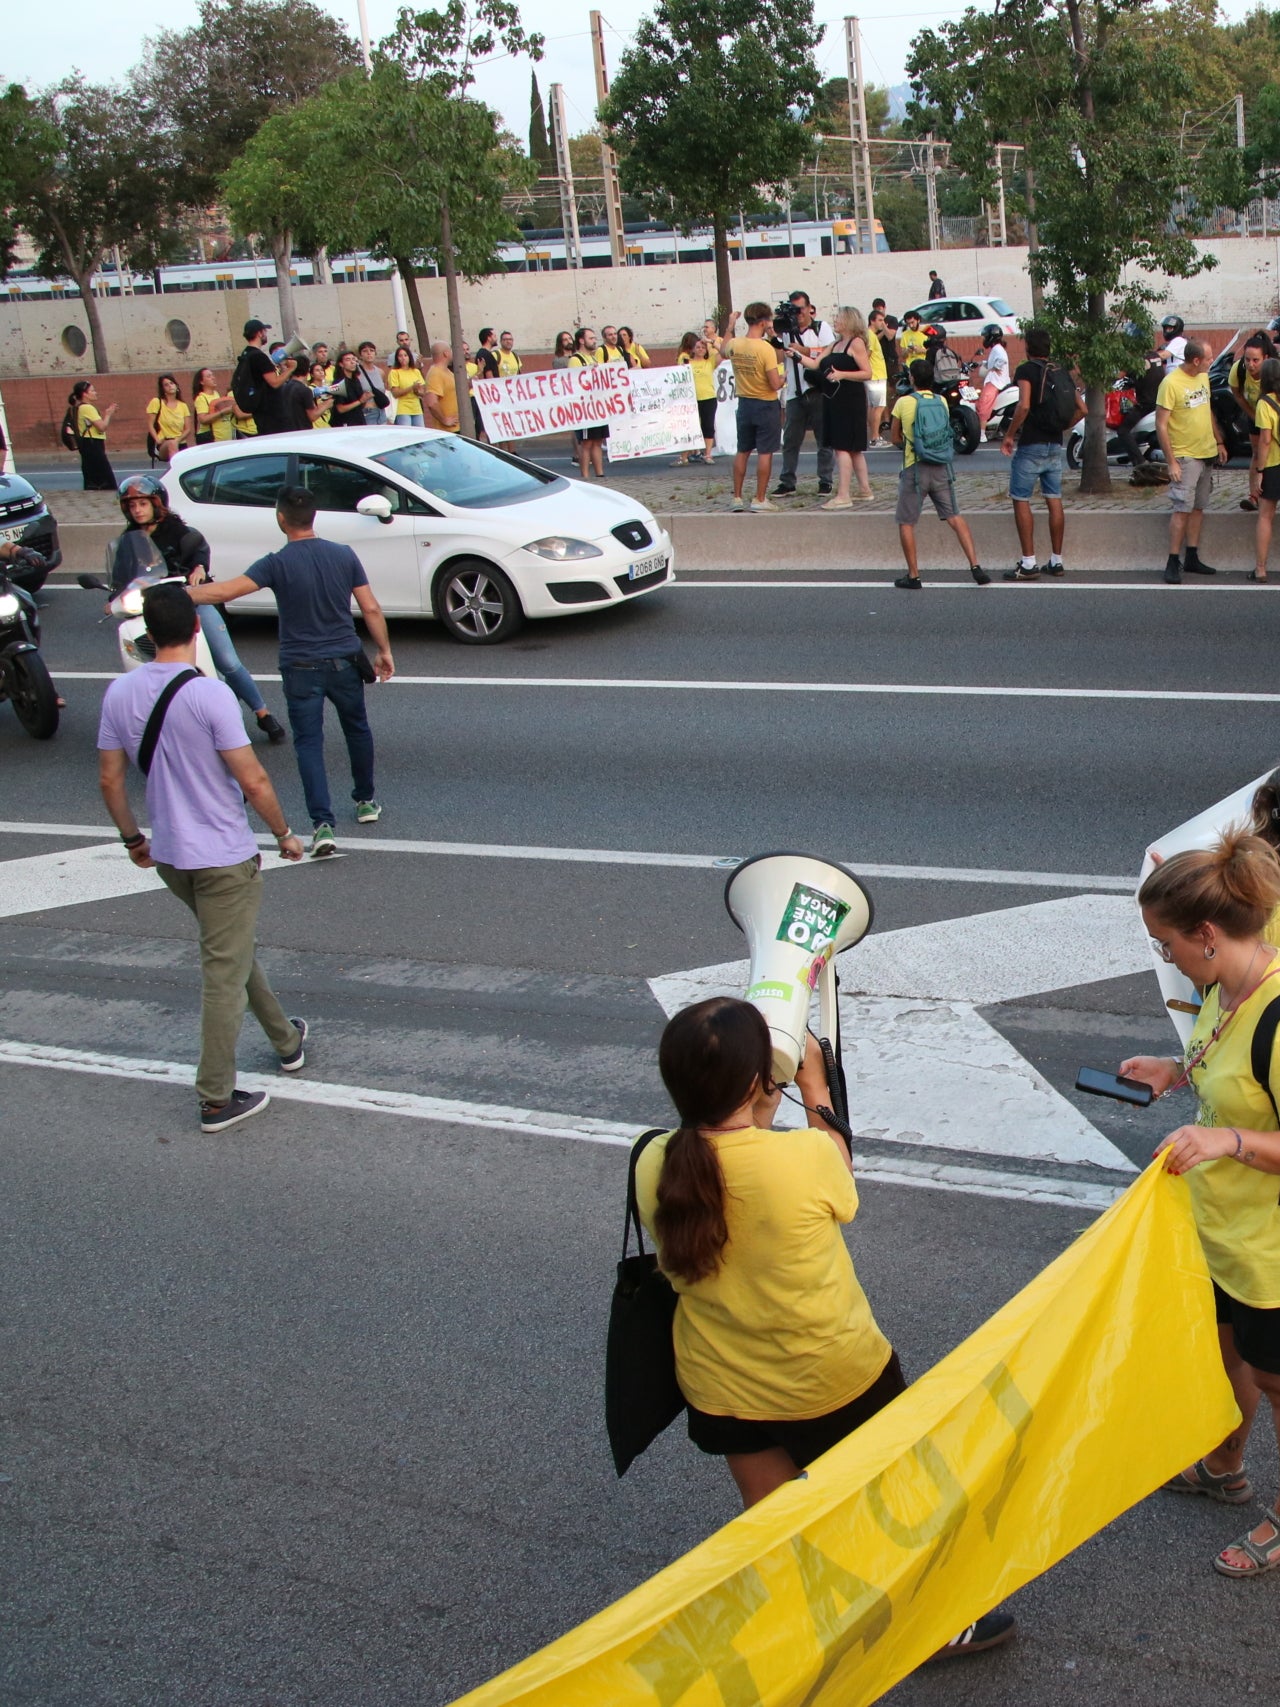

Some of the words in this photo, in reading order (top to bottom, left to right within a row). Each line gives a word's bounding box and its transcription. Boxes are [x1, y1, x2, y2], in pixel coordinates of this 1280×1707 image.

[478, 383, 501, 405] NO
[505, 373, 574, 404] FALTEN
[491, 408, 546, 438] FALTEN
[635, 560, 653, 577] 2068
[792, 906, 833, 936] FARÉ
[800, 893, 837, 923] VAGA
